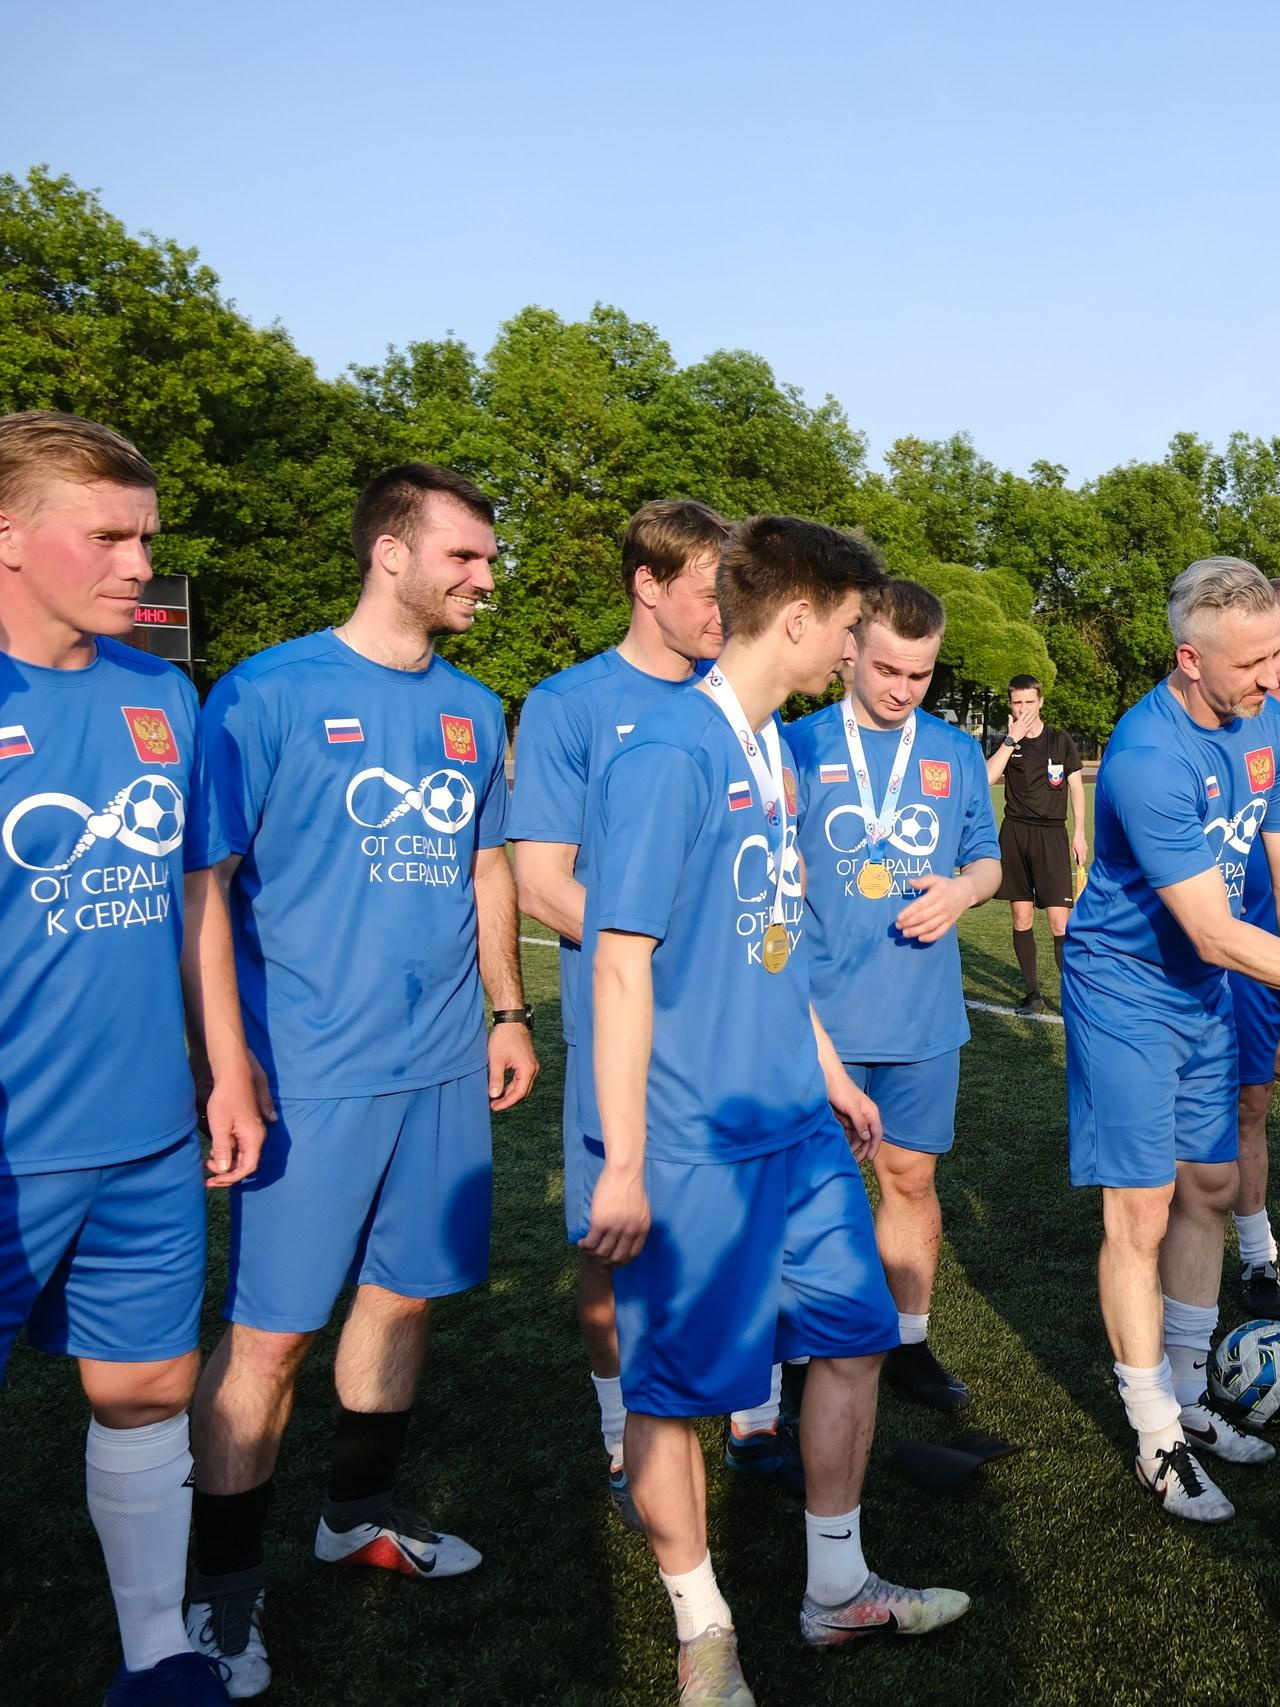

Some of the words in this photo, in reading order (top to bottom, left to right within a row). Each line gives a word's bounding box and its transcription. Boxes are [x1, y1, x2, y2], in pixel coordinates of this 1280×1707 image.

[134, 608, 168, 624] ИНО
[361, 835, 389, 856] ОТ
[370, 862, 383, 882] К
[387, 862, 460, 887] СЕРДЦУ
[836, 858, 859, 876] ОТ
[30, 874, 73, 903] ОТ
[844, 880, 855, 897] К
[47, 908, 69, 936] К
[74, 892, 171, 930] СЕРДЦУ
[736, 911, 767, 936] ОТ
[747, 941, 762, 965] К
